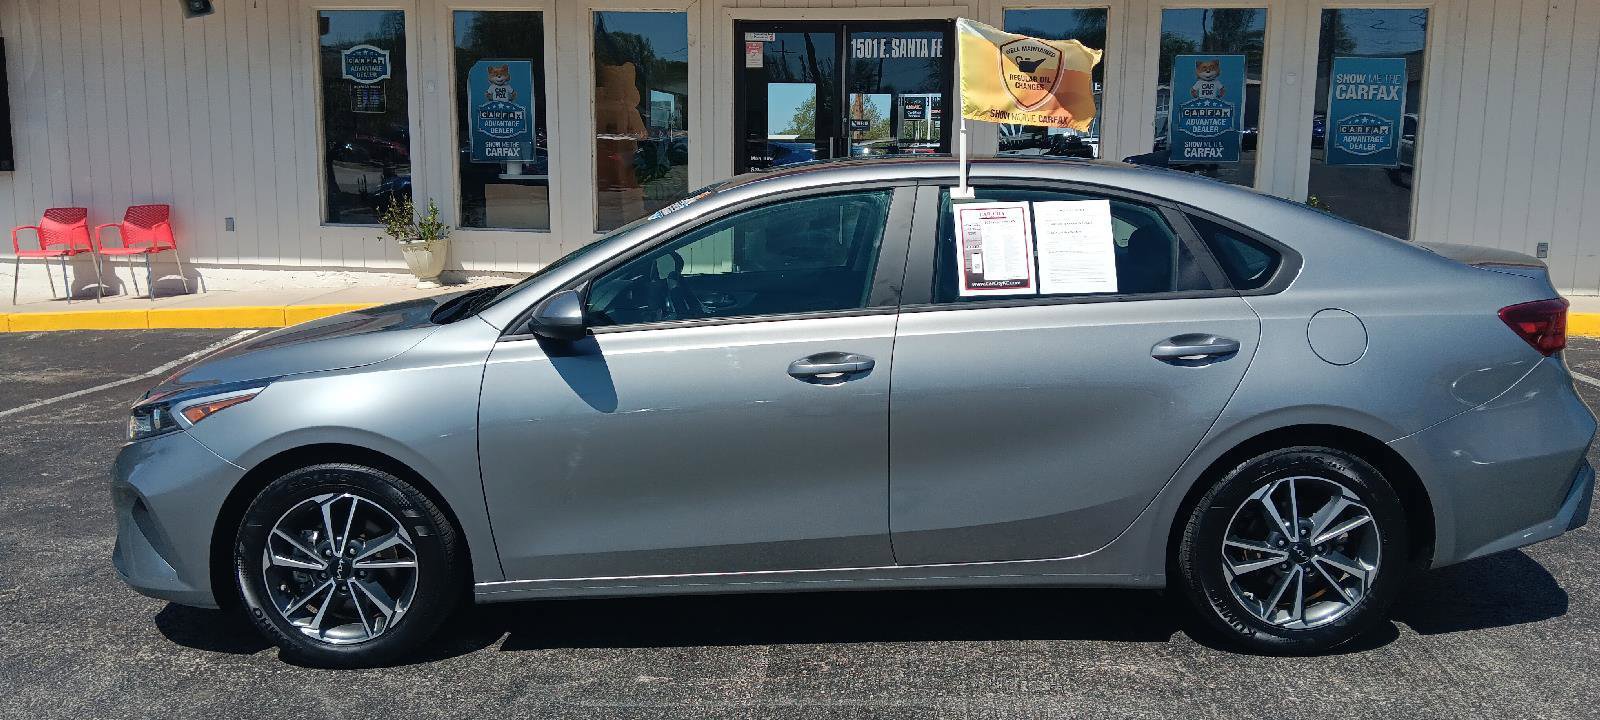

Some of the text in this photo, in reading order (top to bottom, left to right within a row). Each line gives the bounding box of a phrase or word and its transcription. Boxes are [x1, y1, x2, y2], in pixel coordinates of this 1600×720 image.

[851, 38, 943, 58] 1501 E. SANTA FE
[1010, 74, 1038, 82] REGULAR
[1336, 74, 1400, 84] SHOW ME THE
[1015, 82, 1044, 90] CHANGES
[1336, 84, 1399, 100] CARFAX
[990, 109, 1010, 120] SHOW
[1039, 115, 1068, 124] CARFAX
[1184, 109, 1230, 117] CARFAX
[1341, 126, 1388, 134] CARFAX
[486, 148, 520, 156] CARFAX
[1184, 148, 1224, 157] CARFAX
